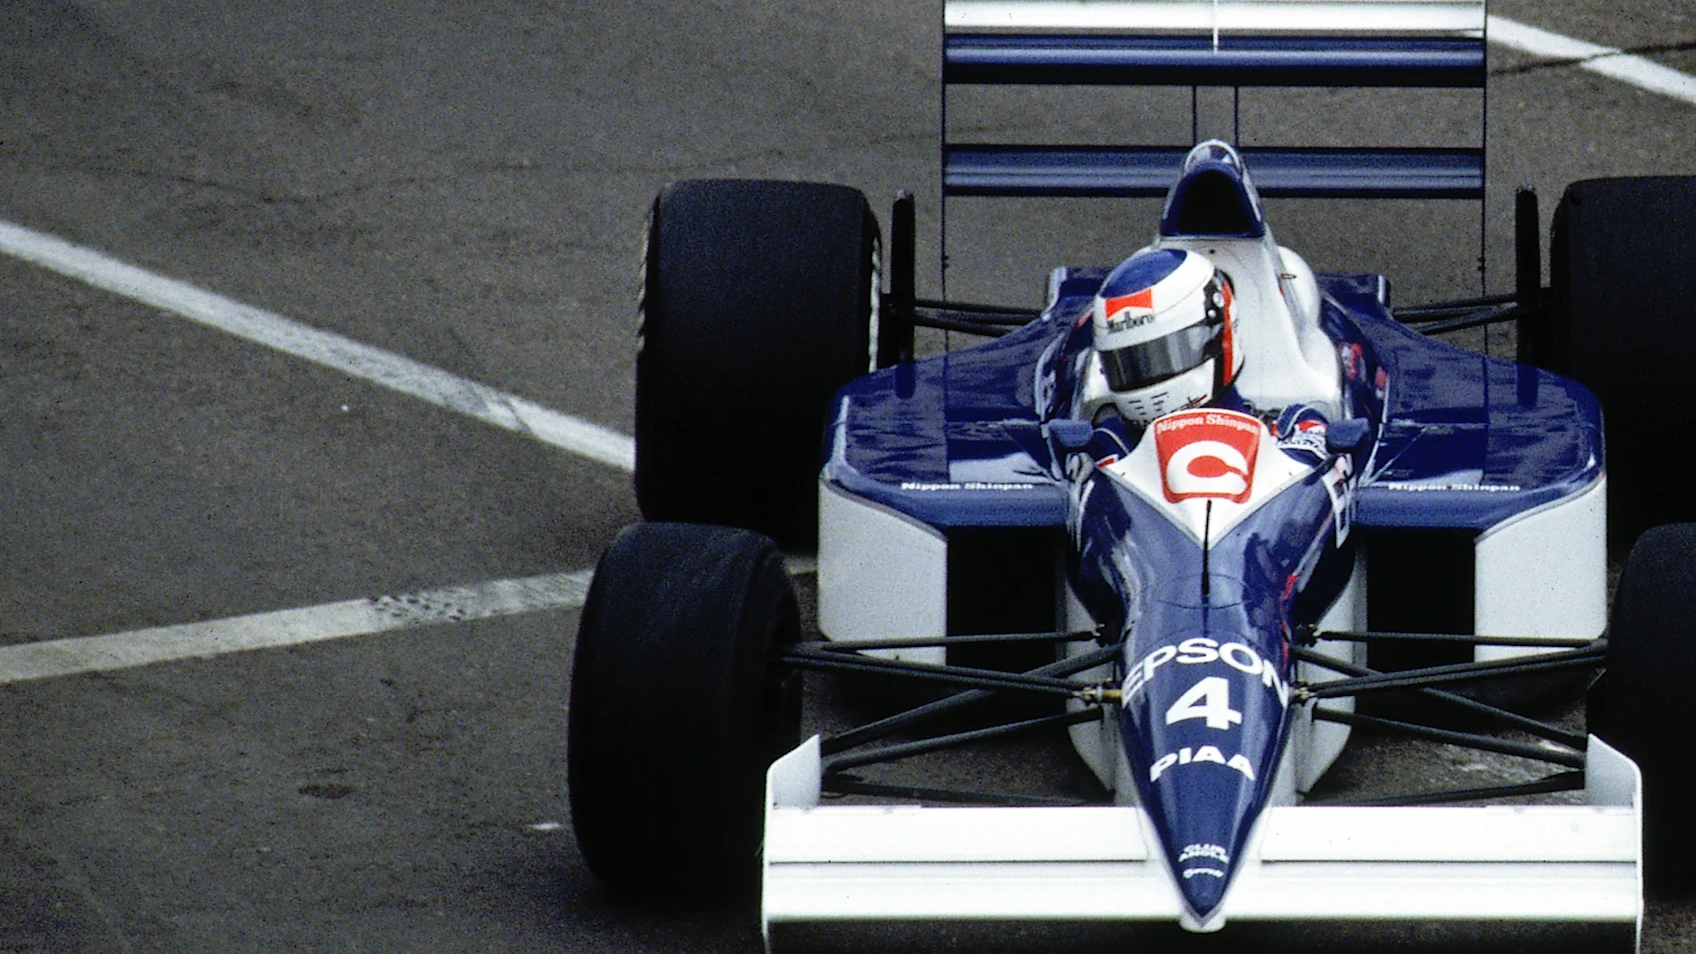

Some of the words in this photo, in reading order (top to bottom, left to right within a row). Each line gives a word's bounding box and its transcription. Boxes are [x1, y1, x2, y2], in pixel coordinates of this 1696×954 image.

[1108, 311, 1154, 333] Marlboro
[1157, 416, 1204, 435] Nippon
[901, 482, 961, 491] Nippon
[1388, 482, 1448, 492] Nippon
[1121, 637, 1289, 709] EPSON
[1166, 676, 1242, 730] 4
[1150, 745, 1255, 782] PIAA
